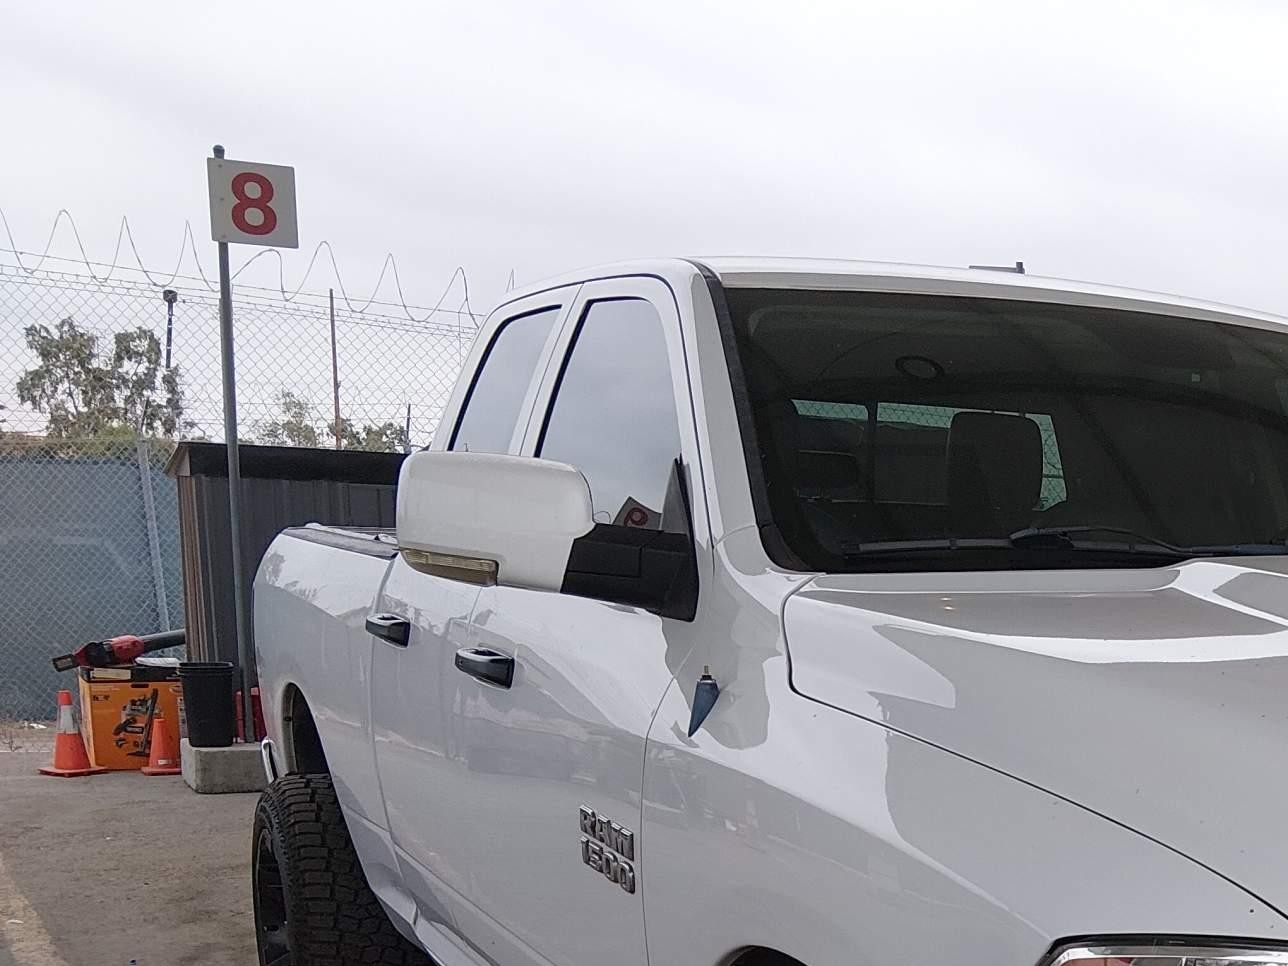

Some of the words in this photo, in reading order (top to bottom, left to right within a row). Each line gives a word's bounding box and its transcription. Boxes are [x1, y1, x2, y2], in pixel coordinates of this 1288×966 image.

[231, 172, 277, 235] 8
[580, 804, 635, 861] RAM
[580, 836, 636, 894] 1500
